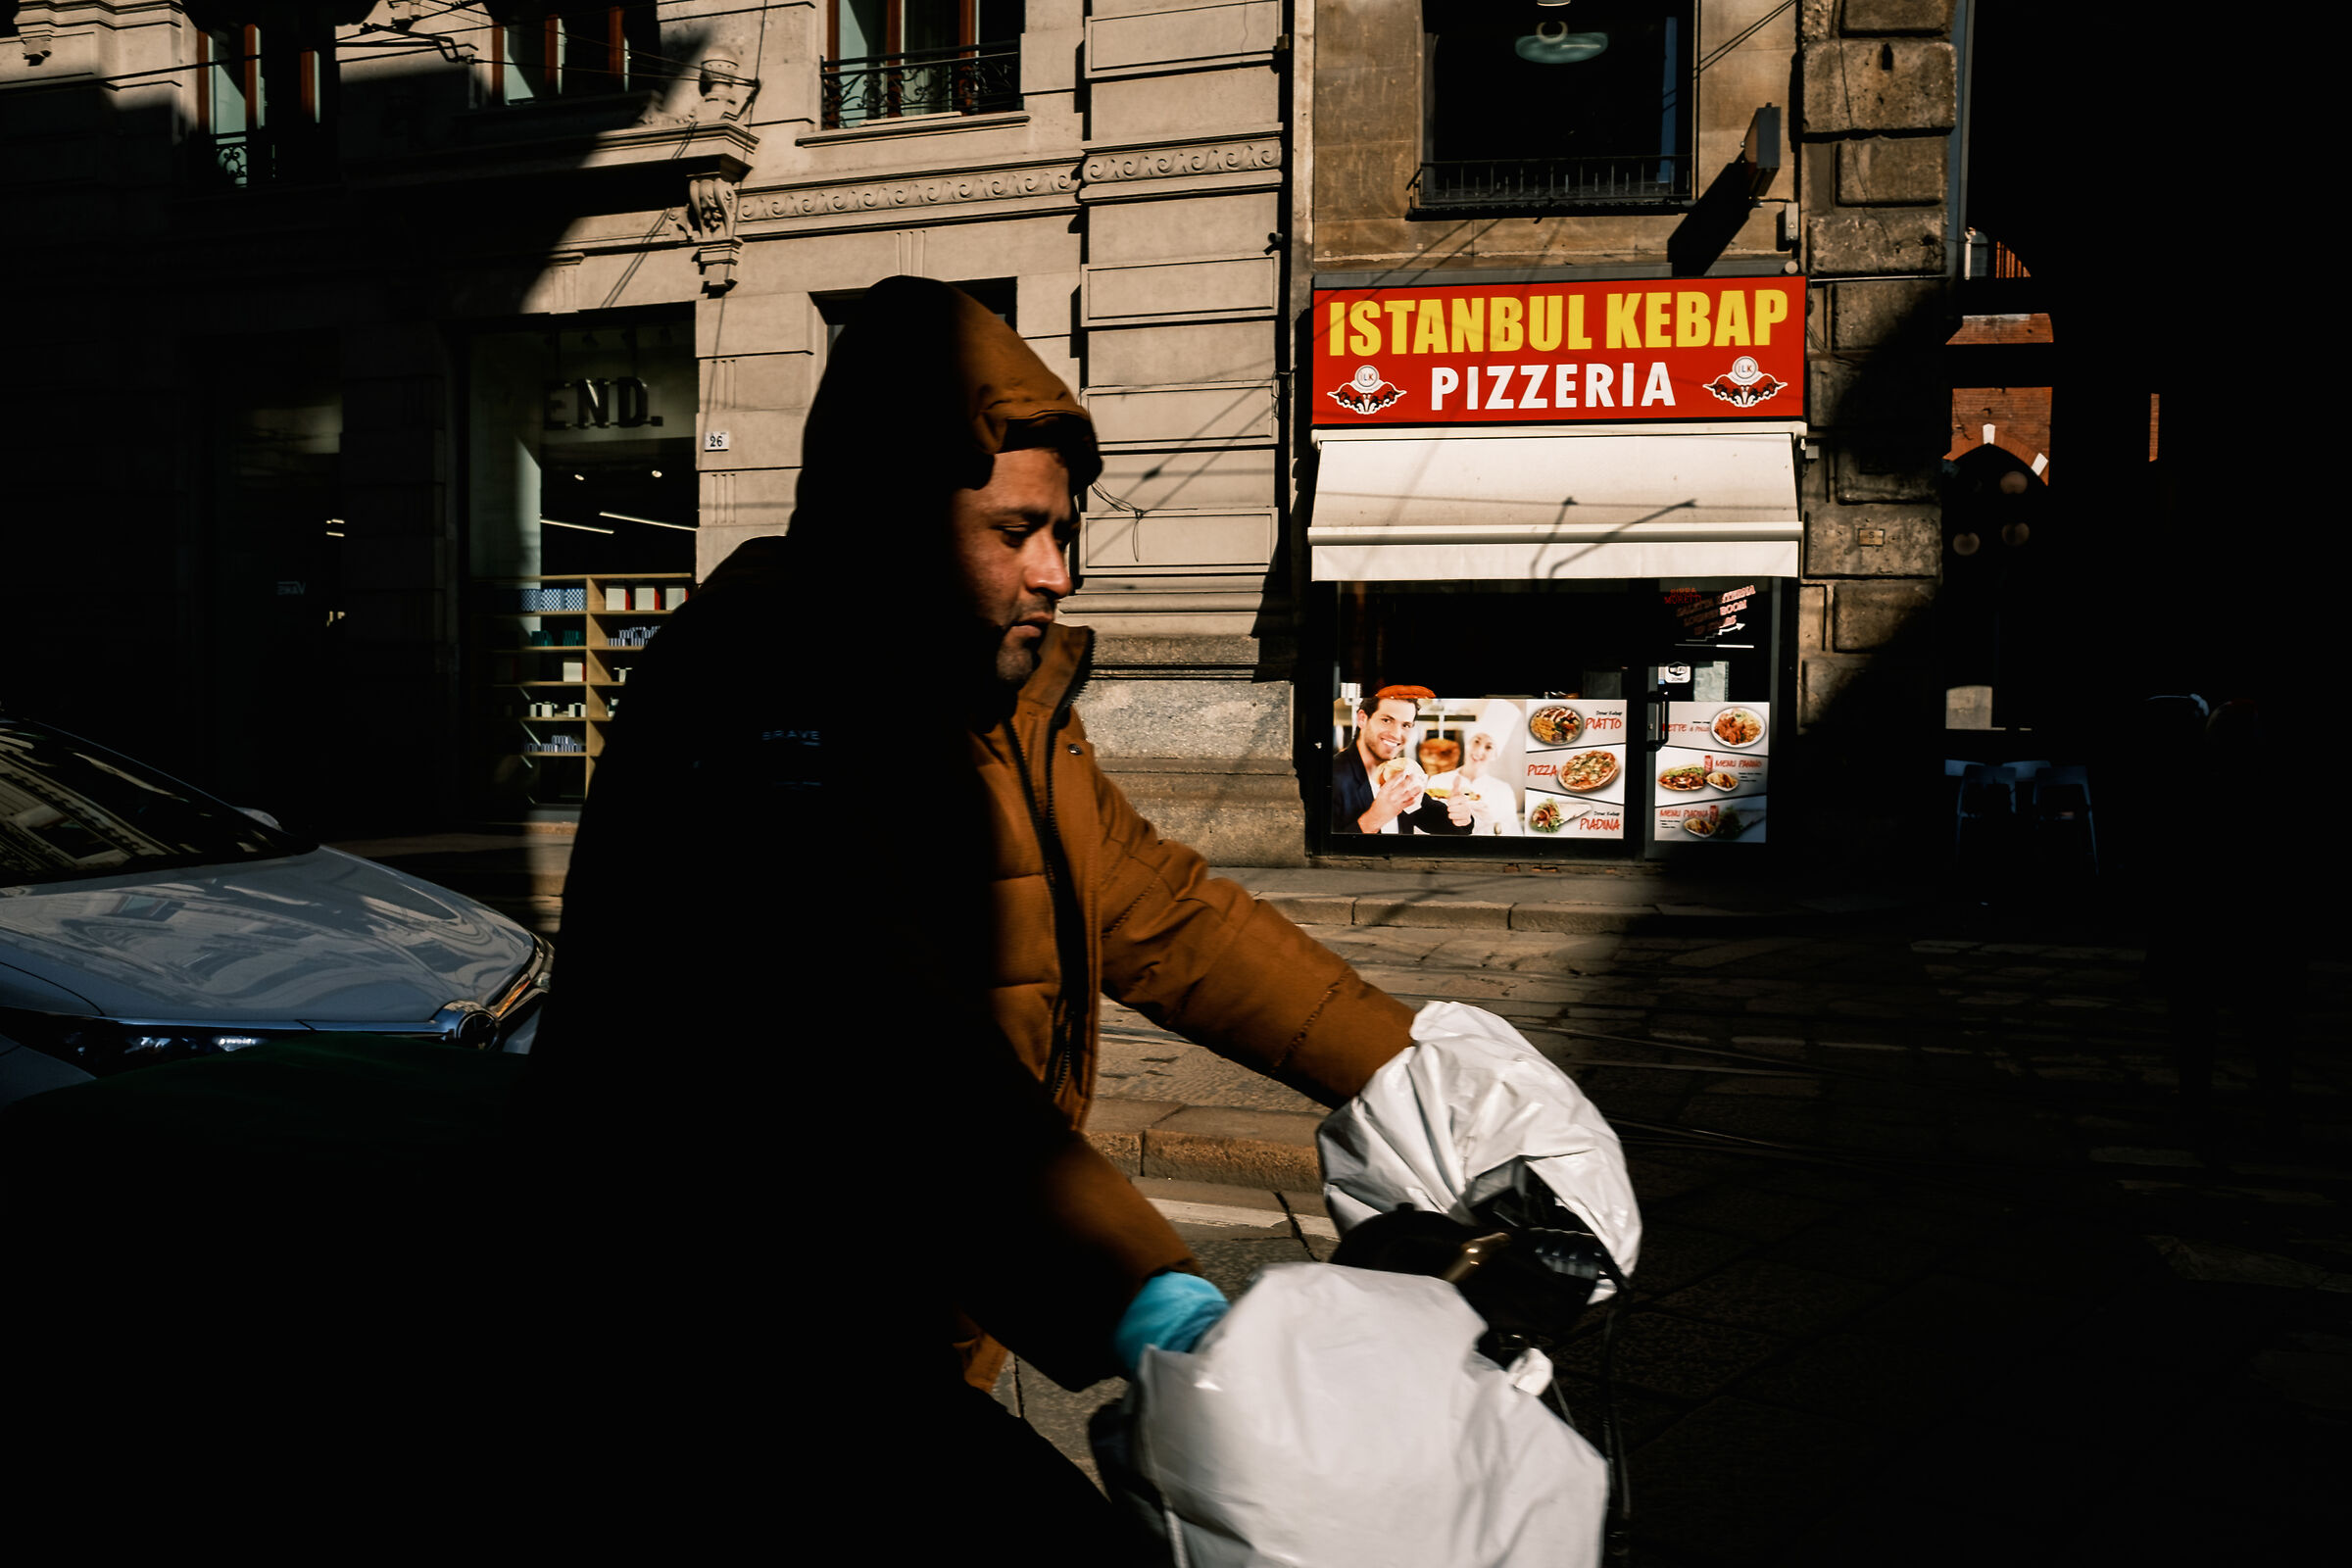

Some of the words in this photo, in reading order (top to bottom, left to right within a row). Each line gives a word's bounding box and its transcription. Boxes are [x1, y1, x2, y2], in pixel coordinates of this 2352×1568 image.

[1329, 294, 1592, 357] ISTANBUL
[1606, 289, 1788, 350] KEBAP
[1431, 362, 1677, 412] PIZZERIA
[710, 435, 723, 447] 26
[1585, 716, 1623, 730] PIATTO
[1527, 764, 1558, 777] PIZZA
[1579, 817, 1621, 831] PIADINA
